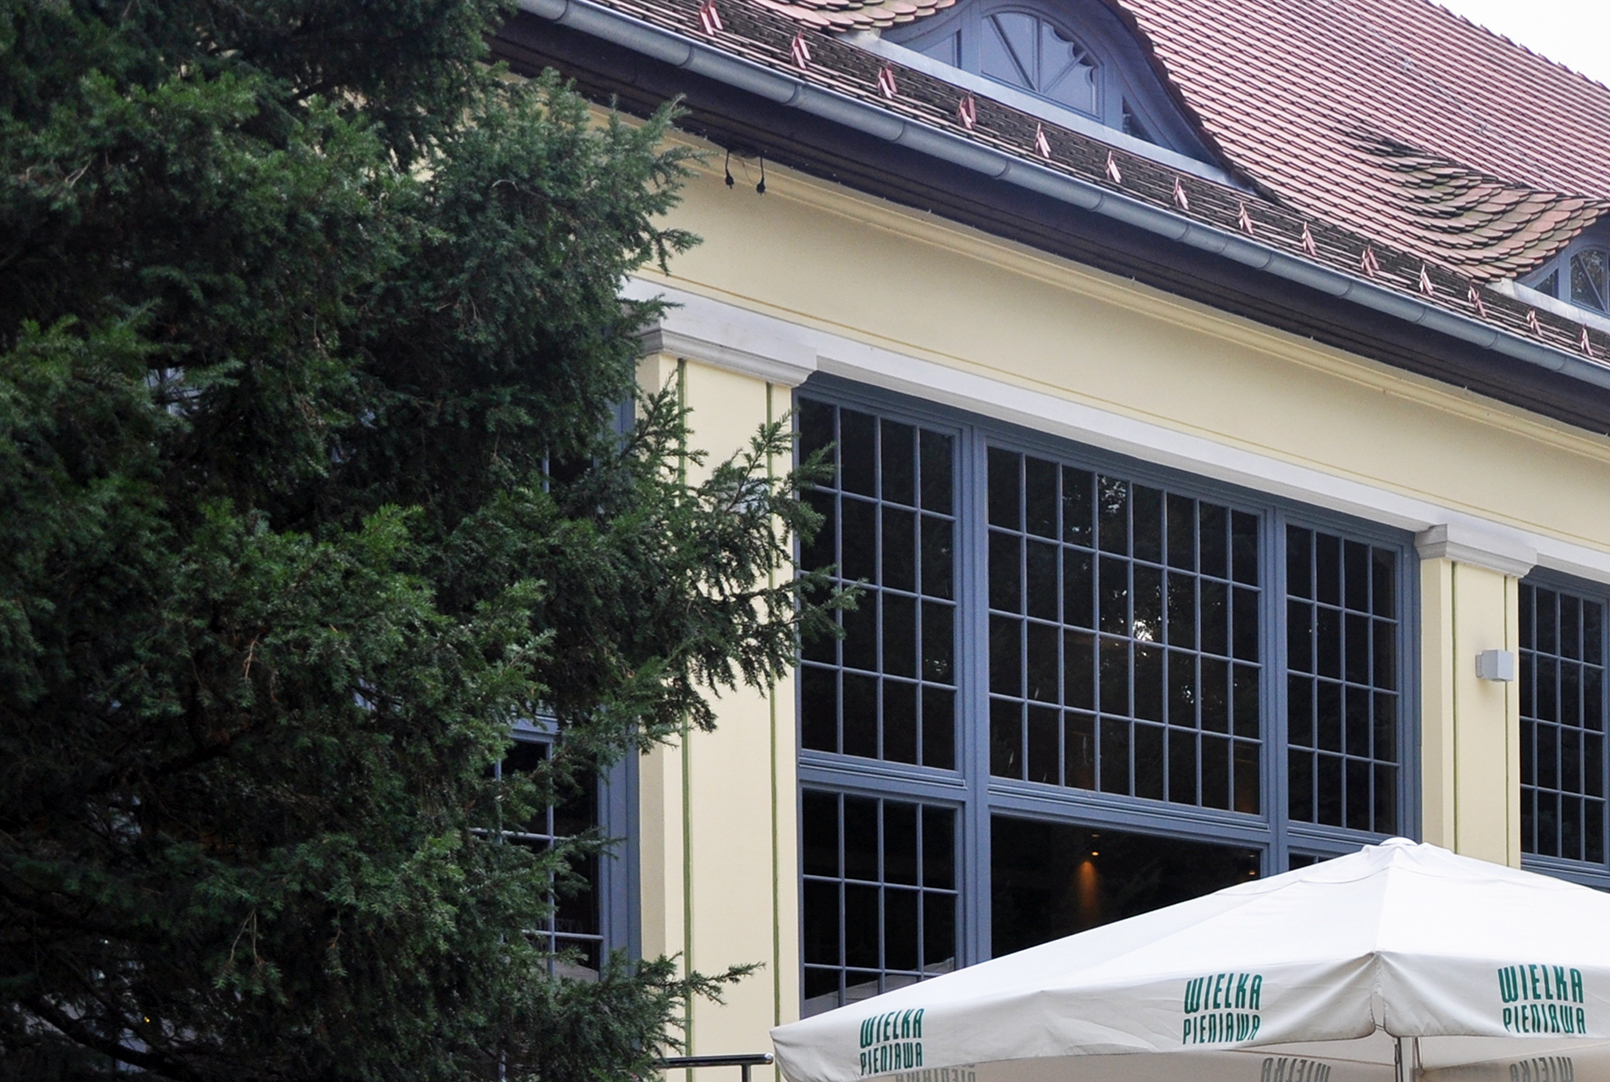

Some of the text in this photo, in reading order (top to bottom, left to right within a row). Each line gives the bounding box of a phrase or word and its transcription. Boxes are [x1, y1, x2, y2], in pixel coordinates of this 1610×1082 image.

[1184, 973, 1263, 1014] WIELKA
[1498, 964, 1584, 1003] WIELKA
[860, 1008, 925, 1049] WIELKA
[1182, 1012, 1261, 1045] PIENIAWA
[1503, 1004, 1586, 1034] PIENIAWA
[860, 1042, 923, 1076] PIENIAWA
